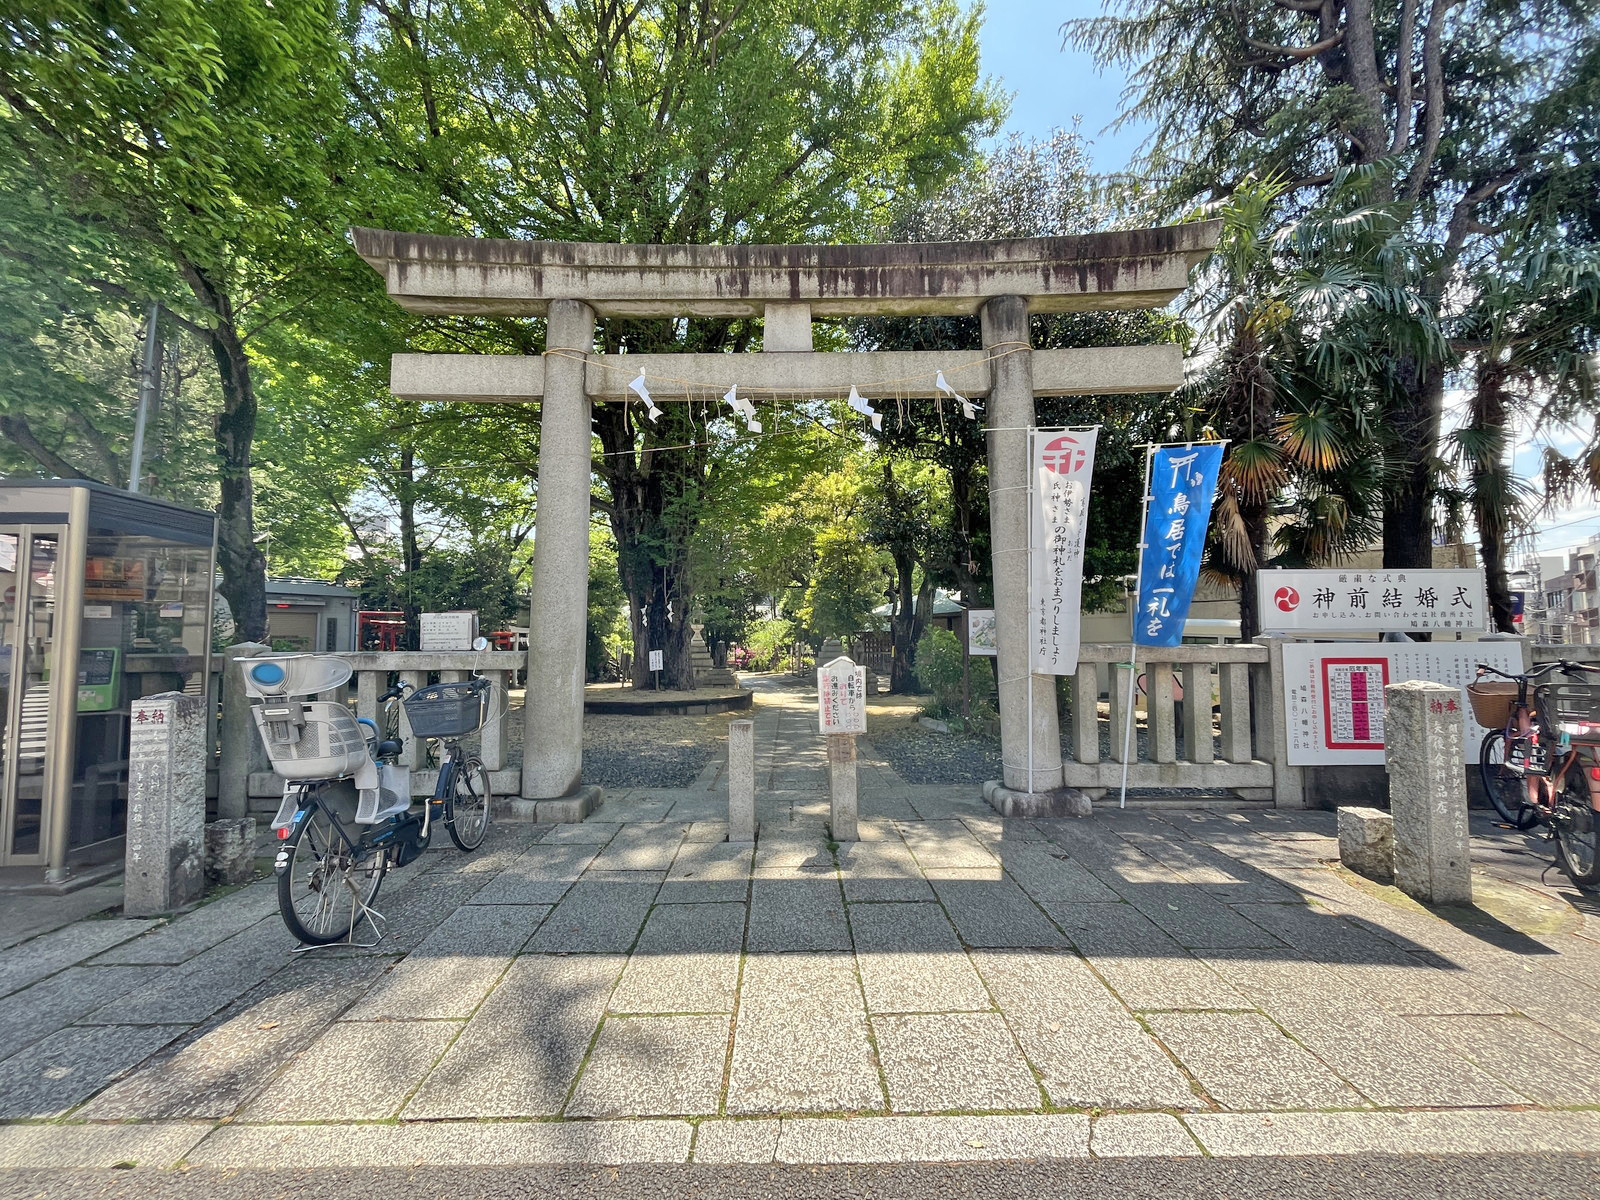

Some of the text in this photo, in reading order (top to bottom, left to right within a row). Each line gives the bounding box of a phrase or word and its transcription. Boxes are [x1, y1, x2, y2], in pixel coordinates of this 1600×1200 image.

[1051, 481, 1061, 523] 氏神さま
[1063, 481, 1073, 523] お伊勢さま
[1147, 492, 1191, 637] 鳥居では一礼を
[1338, 574, 1407, 583] 厳粛な式典
[1051, 526, 1067, 665] の御神札をおまつりしましょう
[1312, 586, 1473, 610] 神前結婚式
[1039, 597, 1047, 656] 東京都神社庁
[1410, 620, 1474, 628] 鳩森八幡神社
[135, 709, 164, 724] 奉納
[831, 676, 839, 725] お進みください
[1430, 697, 1459, 714] 奉納
